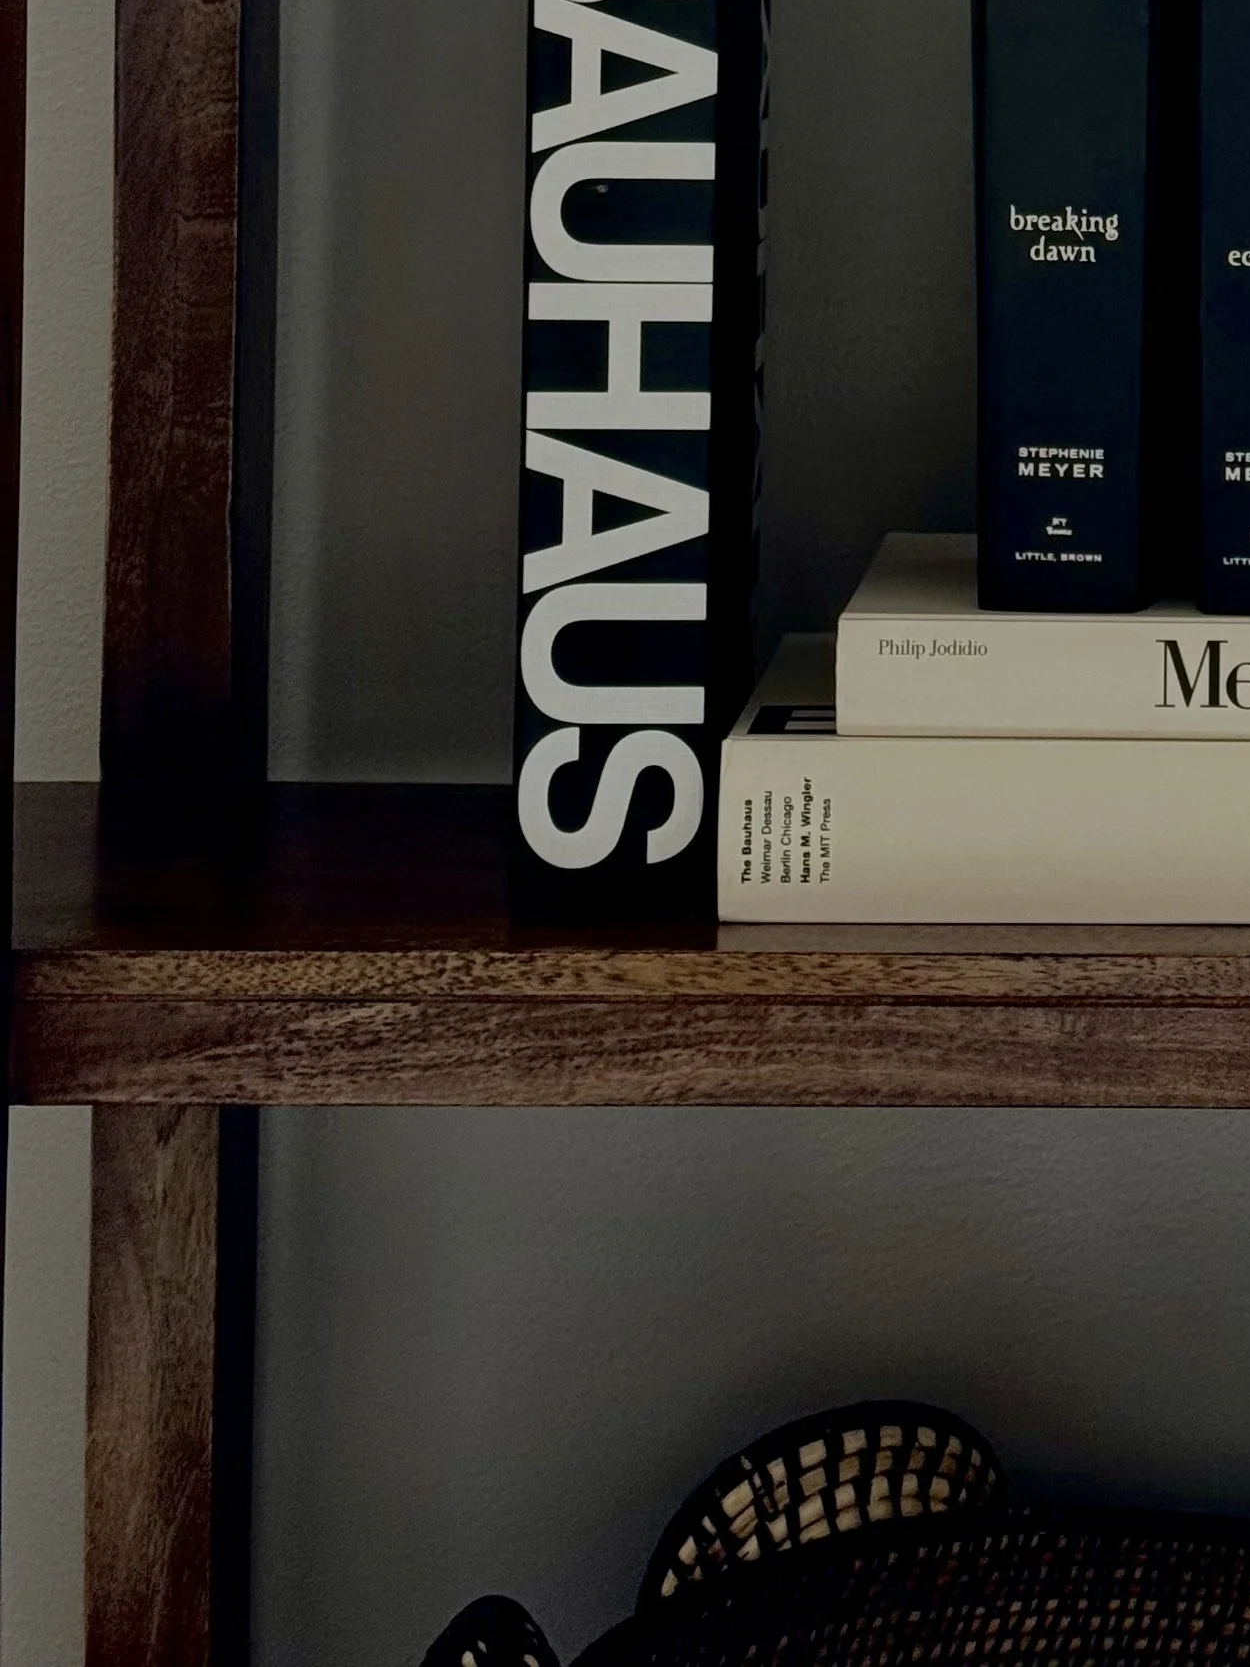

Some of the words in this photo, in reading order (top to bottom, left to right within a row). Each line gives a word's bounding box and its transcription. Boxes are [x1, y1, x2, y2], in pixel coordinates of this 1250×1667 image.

[1009, 204, 1119, 241] breaking
[1029, 237, 1097, 263] dawn
[1018, 446, 1105, 460] STEPHENIE
[1018, 462, 1105, 479] MEYER
[1060, 552, 1103, 563] BROWN
[878, 639, 926, 660] Philip
[929, 639, 988, 658] Jodidio
[761, 790, 772, 835] Dessau
[801, 777, 814, 828] Wingler
[820, 798, 831, 832] Press
[742, 799, 753, 857] Bauhaus
[781, 796, 795, 846] Chicago
[801, 831, 812, 848] M.
[820, 836, 831, 858] MIT
[741, 860, 752, 884] The
[761, 837, 772, 884] Weimar
[780, 848, 791, 884] Berlin
[800, 852, 811, 884] Hans
[820, 861, 831, 884] The
